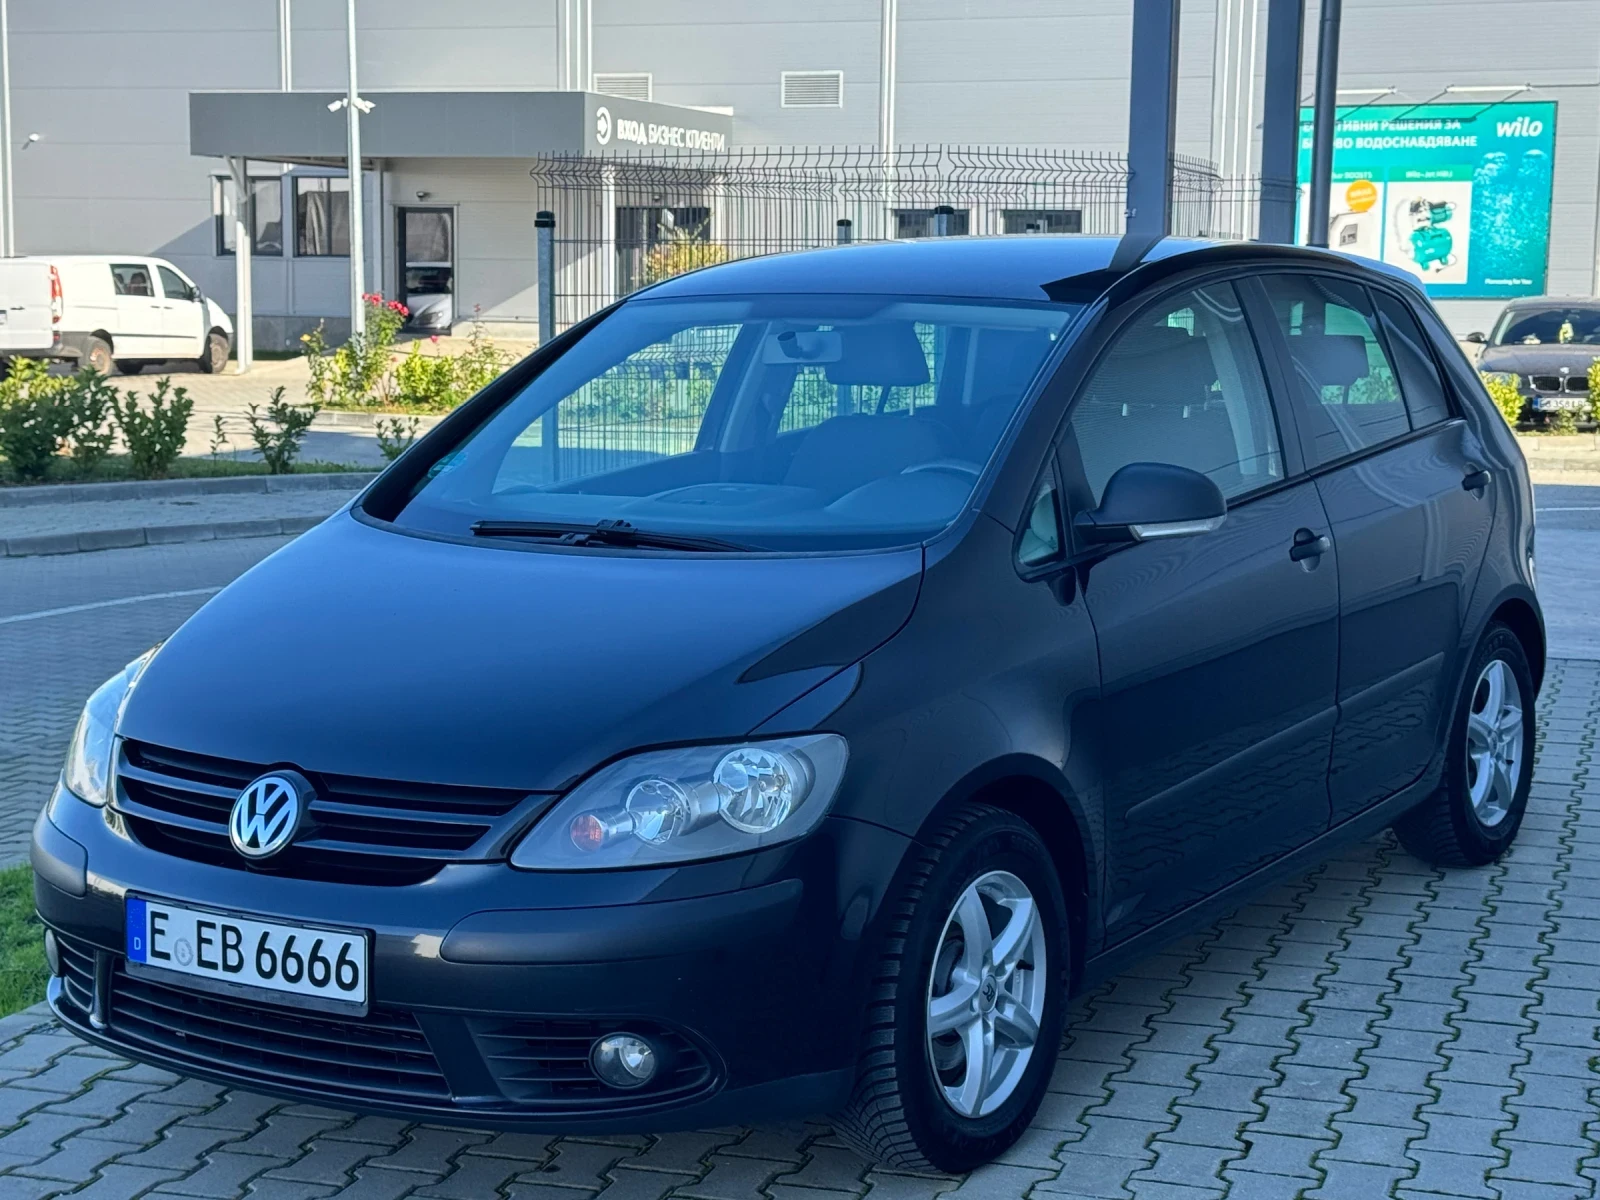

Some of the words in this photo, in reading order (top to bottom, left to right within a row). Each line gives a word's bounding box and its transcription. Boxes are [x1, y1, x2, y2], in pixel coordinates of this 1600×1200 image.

[617, 119, 648, 146] ВХОД
[648, 123, 685, 148] БИЗНЕС
[1380, 119, 1442, 132] РЕШЕНИЯ
[1443, 119, 1462, 130] ЗА
[1496, 116, 1543, 138] wilo
[1355, 135, 1478, 150] ВОДОСНАБДЯВАНЕ
[133, 937, 141, 951] D
[150, 910, 171, 961] E
[196, 919, 245, 974] EB
[255, 930, 360, 992] 6666
